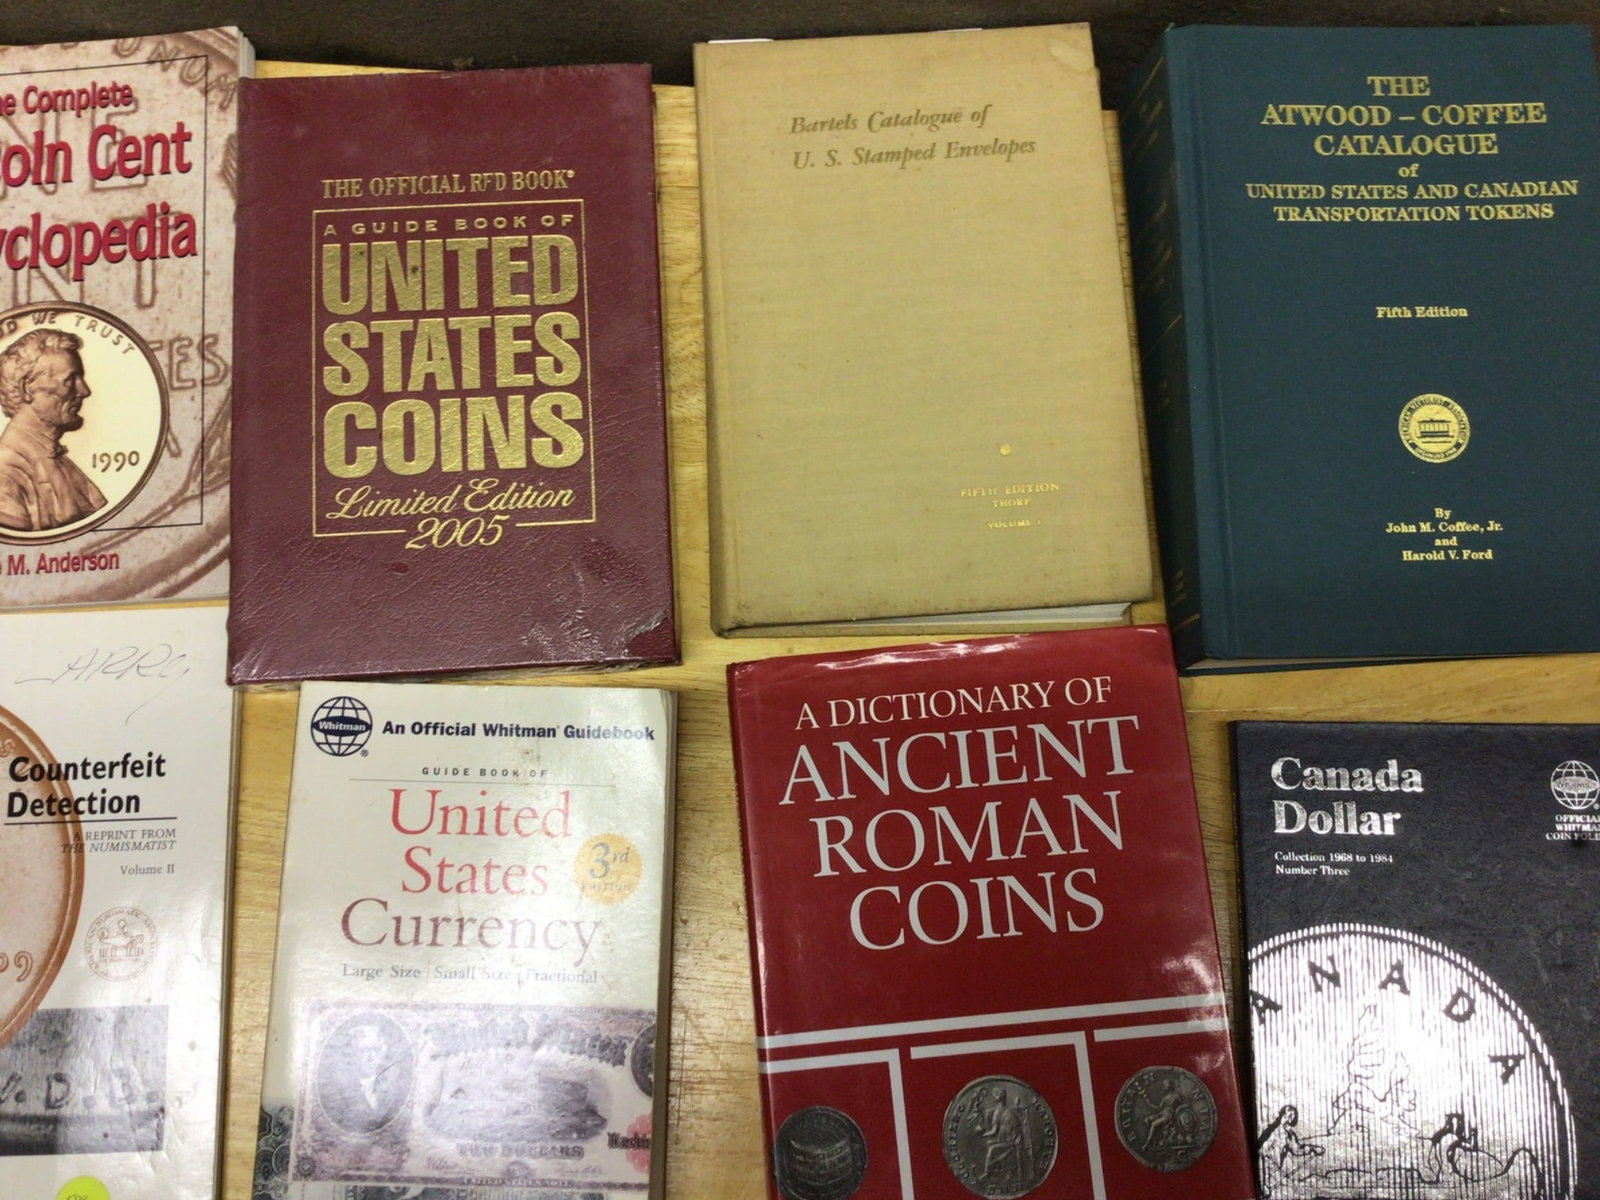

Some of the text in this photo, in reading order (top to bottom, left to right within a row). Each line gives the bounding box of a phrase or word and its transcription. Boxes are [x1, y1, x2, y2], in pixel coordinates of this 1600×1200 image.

[1366, 76, 1430, 97] THE
[23, 81, 133, 117] Complete
[791, 104, 993, 134] Bartels Catalogue of
[1260, 103, 1547, 126] ATWOOD COFFEE
[88, 121, 192, 181] Cent
[793, 138, 1036, 169] U. S. Stamped Envelopes
[1314, 133, 1498, 155] CATALOGUE
[1398, 163, 1419, 178] of
[321, 178, 363, 198] THE
[369, 174, 466, 197] OFFICIAL
[1245, 181, 1579, 199] UNITED STATES AND CANADIAN
[1273, 204, 1554, 222] TRANSPORTATION TOKENS
[324, 215, 574, 236] A GUIDE BOOK OF
[322, 234, 579, 315] UNITED
[1376, 306, 1468, 318] Fifth Edition
[32, 311, 57, 325] WE
[74, 314, 135, 355] TRUST
[322, 311, 582, 396] STATES
[323, 392, 584, 478] COINS
[92, 450, 140, 473] 1990
[325, 478, 576, 519] Limited Edition
[1434, 508, 1452, 520] By
[405, 514, 510, 550] 2005
[1385, 520, 1503, 534] John M. Coffee, Jr.
[1434, 536, 1458, 546] and
[7, 552, 120, 576] M. Anderson
[1402, 549, 1493, 561] Harold V. Ford
[795, 676, 1112, 730] A DICTIONARY OF
[319, 720, 366, 731] Whitman
[382, 721, 405, 735] An
[411, 721, 476, 737] Official
[563, 725, 655, 740] Guidebook
[9, 751, 166, 782] Counterfeit
[779, 715, 1140, 805] ANCIENT
[422, 766, 548, 778] GUIDE BOOK OF
[1271, 756, 1424, 792] Canada
[7, 788, 141, 818] Detection
[388, 788, 573, 838] United
[1273, 800, 1401, 835] Dollar
[73, 828, 176, 841] A REPRINT FROM
[809, 790, 1123, 878] ROMAN
[1545, 832, 1571, 841] COIN
[61, 840, 176, 854] THE NUMISMATIST
[1275, 851, 1393, 863] Collection 1968 to 1984
[120, 864, 162, 875] Volume
[401, 845, 549, 896] States
[1275, 864, 1350, 876] Number Three
[850, 868, 1104, 950] COINS
[341, 897, 602, 967] Currency
[342, 963, 383, 982] Large
[389, 964, 422, 979] Size
[434, 965, 475, 980] Small
